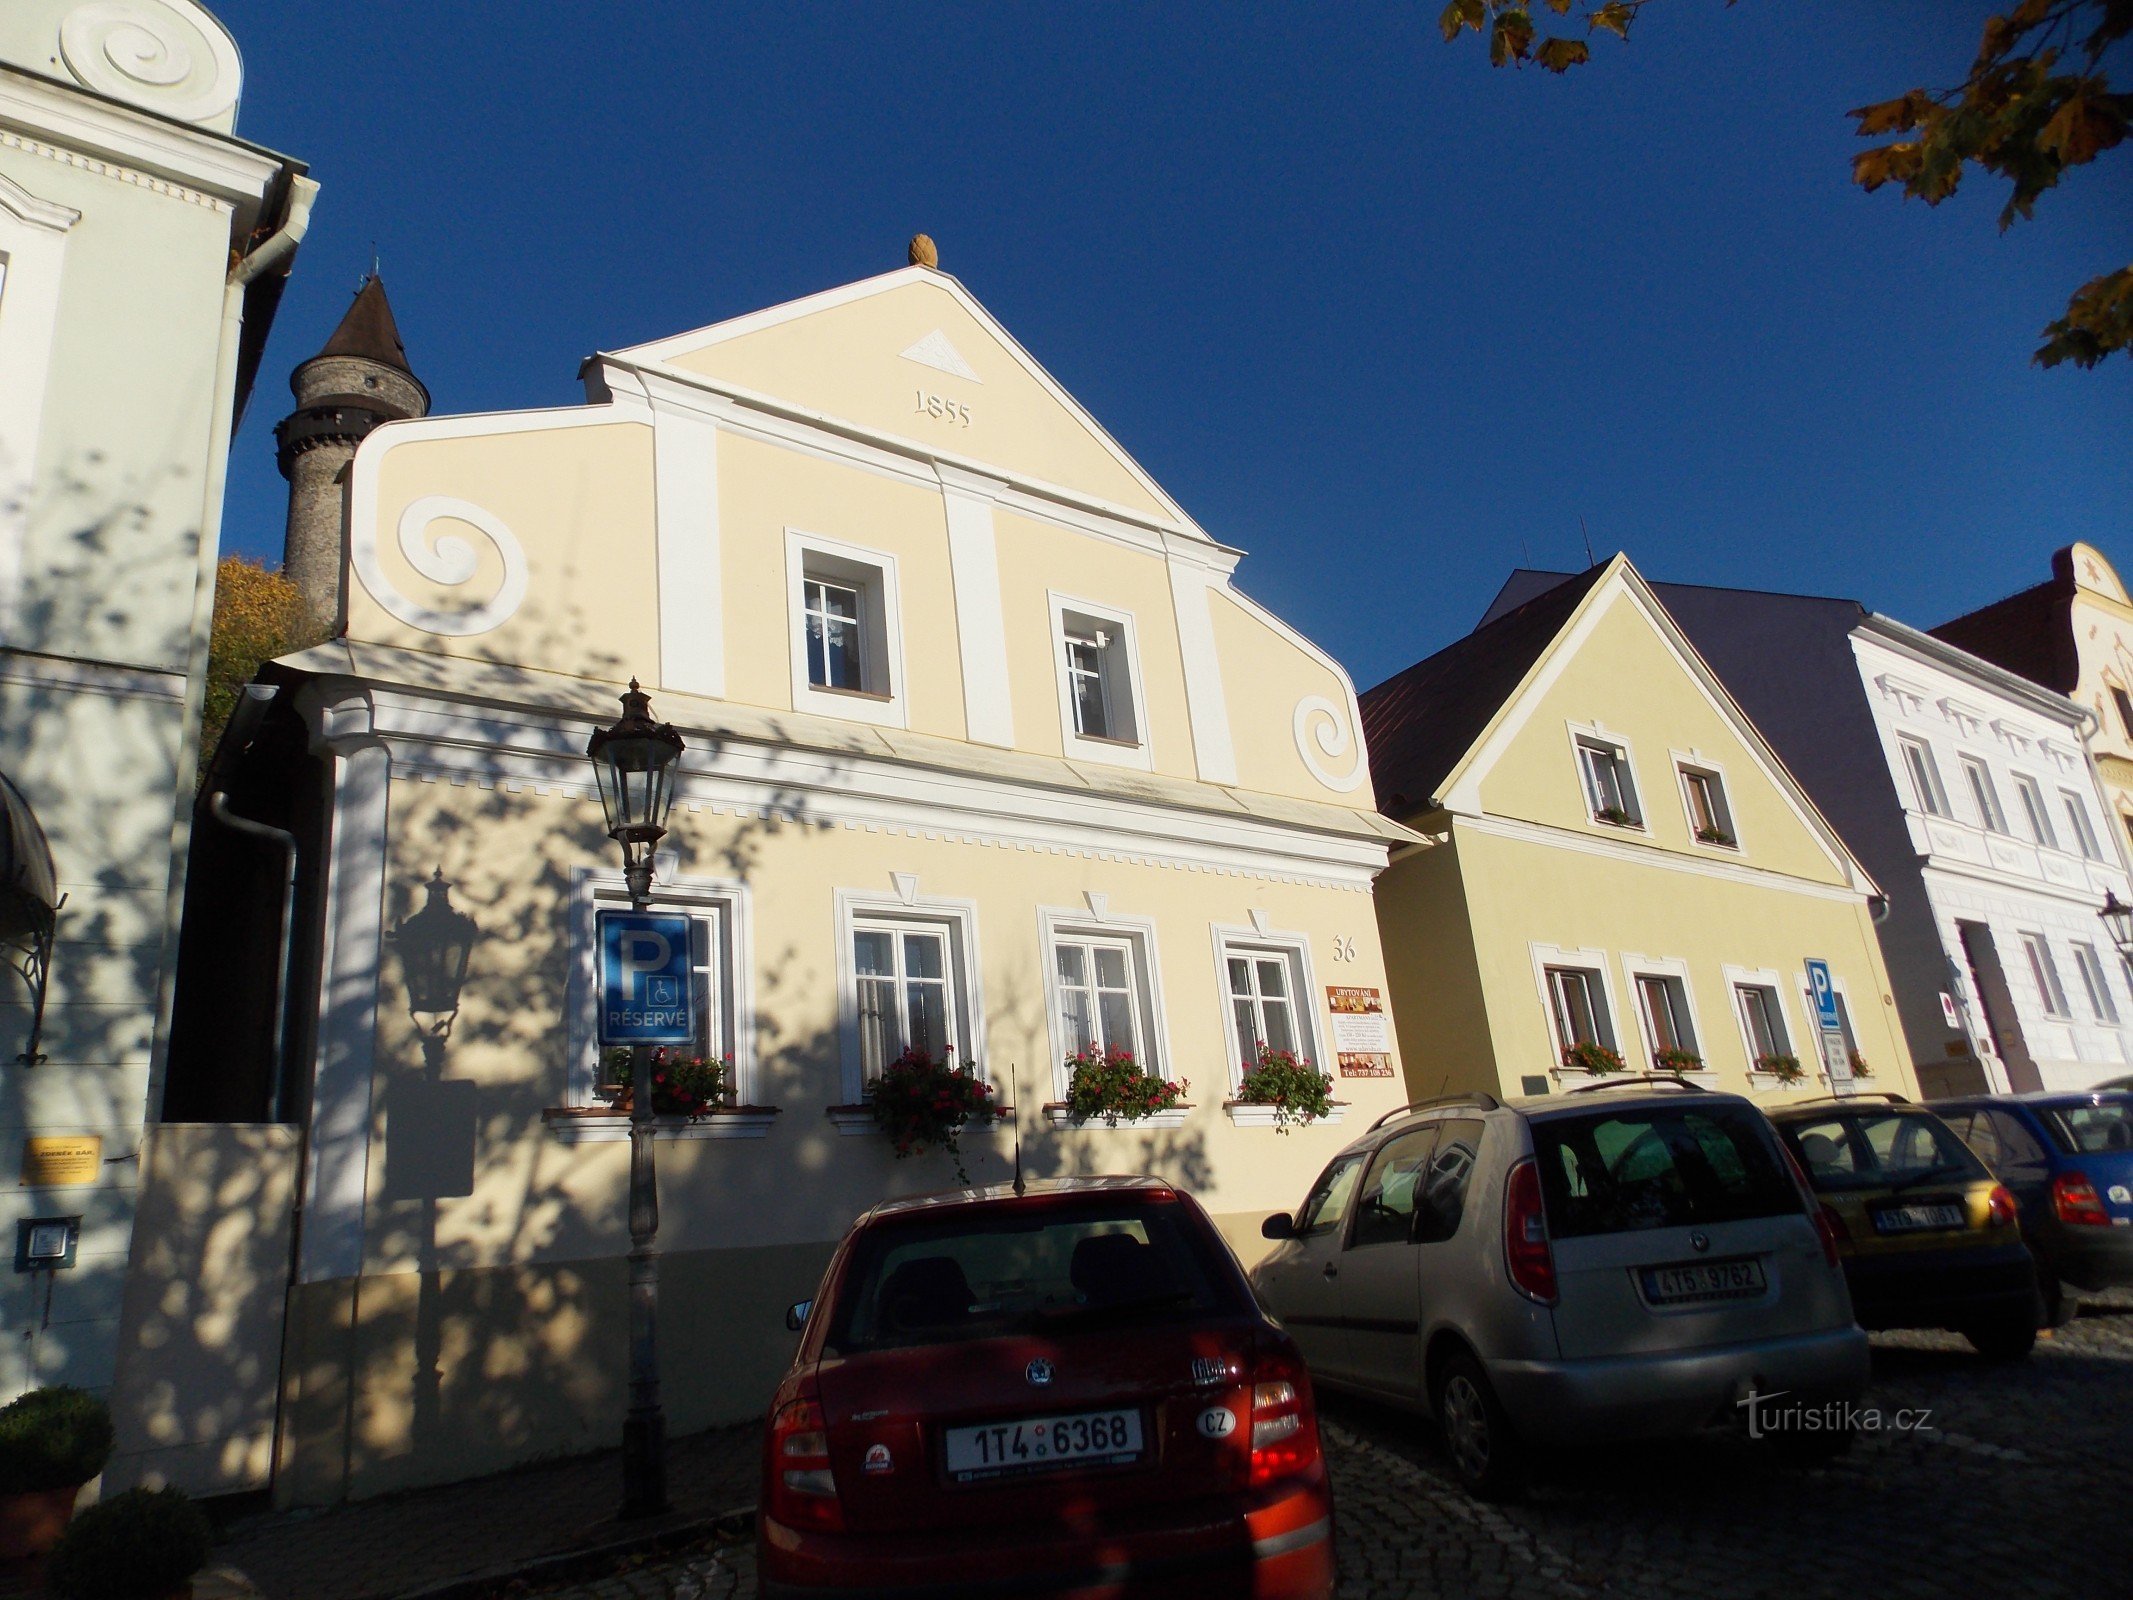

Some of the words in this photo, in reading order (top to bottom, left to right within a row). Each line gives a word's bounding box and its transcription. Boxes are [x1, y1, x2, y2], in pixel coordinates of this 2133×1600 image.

[914, 390, 973, 429] 1855
[1332, 934, 1356, 963] 36
[620, 929, 672, 1001] P
[1812, 967, 1828, 1007] P
[609, 1008, 687, 1027] RÉSERVÉ
[1357, 1069, 1369, 1077] 737
[1663, 1269, 1697, 1293] 4T5
[1708, 1264, 1755, 1290] 9762
[1204, 1411, 1227, 1433] CZ
[975, 1426, 1029, 1464] 1T4
[1053, 1415, 1128, 1455] 6368
